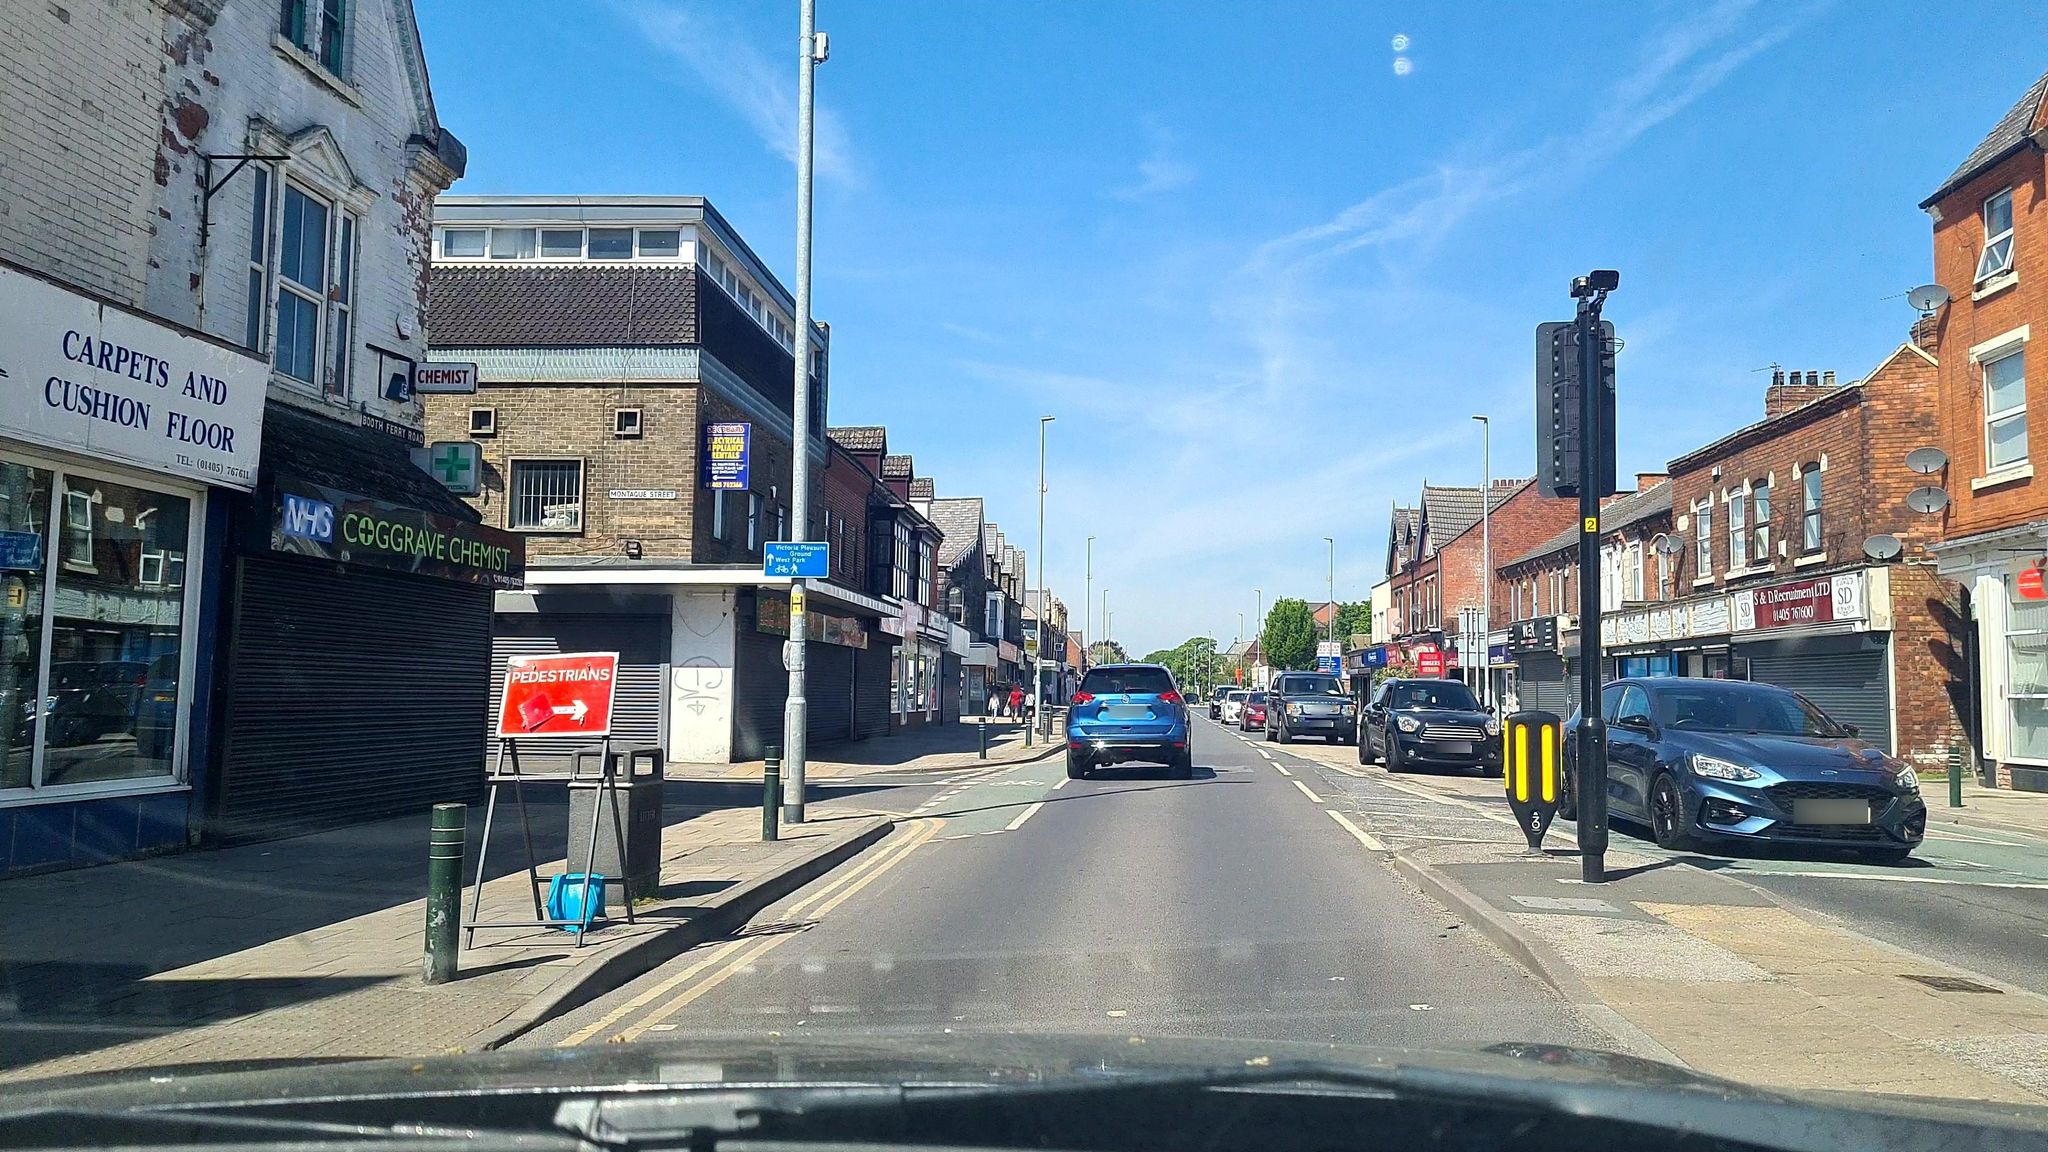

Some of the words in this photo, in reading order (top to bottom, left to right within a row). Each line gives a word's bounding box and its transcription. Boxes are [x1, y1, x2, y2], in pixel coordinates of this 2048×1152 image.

[63, 330, 170, 388] CARPETS
[182, 371, 227, 406] AND
[417, 369, 469, 384] CHEMIST
[45, 376, 151, 431] CUSHION
[166, 411, 235, 453] FLOOR
[362, 415, 383, 431] BOOTH
[386, 423, 406, 438] FERRY
[407, 431, 424, 444] ROAD
[707, 444, 744, 452] APPLIANCE
[176, 454, 193, 467] TEL:
[196, 460, 223, 475] (01405)
[226, 466, 249, 480] 767611
[610, 490, 647, 498] MONTAGUE
[288, 498, 334, 538] NHS
[1587, 520, 1594, 531] 2
[343, 513, 445, 560] COGGRAVE
[450, 537, 511, 573] CHEMIST
[1754, 592, 1758, 606] S
[1760, 590, 1766, 605] &
[1768, 589, 1774, 605] D
[1774, 586, 1814, 603] Recruitment
[1814, 582, 1830, 597] LTD
[1838, 586, 1853, 605] SD
[792, 595, 803, 612] H
[1740, 602, 1751, 618] SD
[1773, 608, 1790, 622] 01405
[511, 668, 610, 684] PEDESTRIANS
